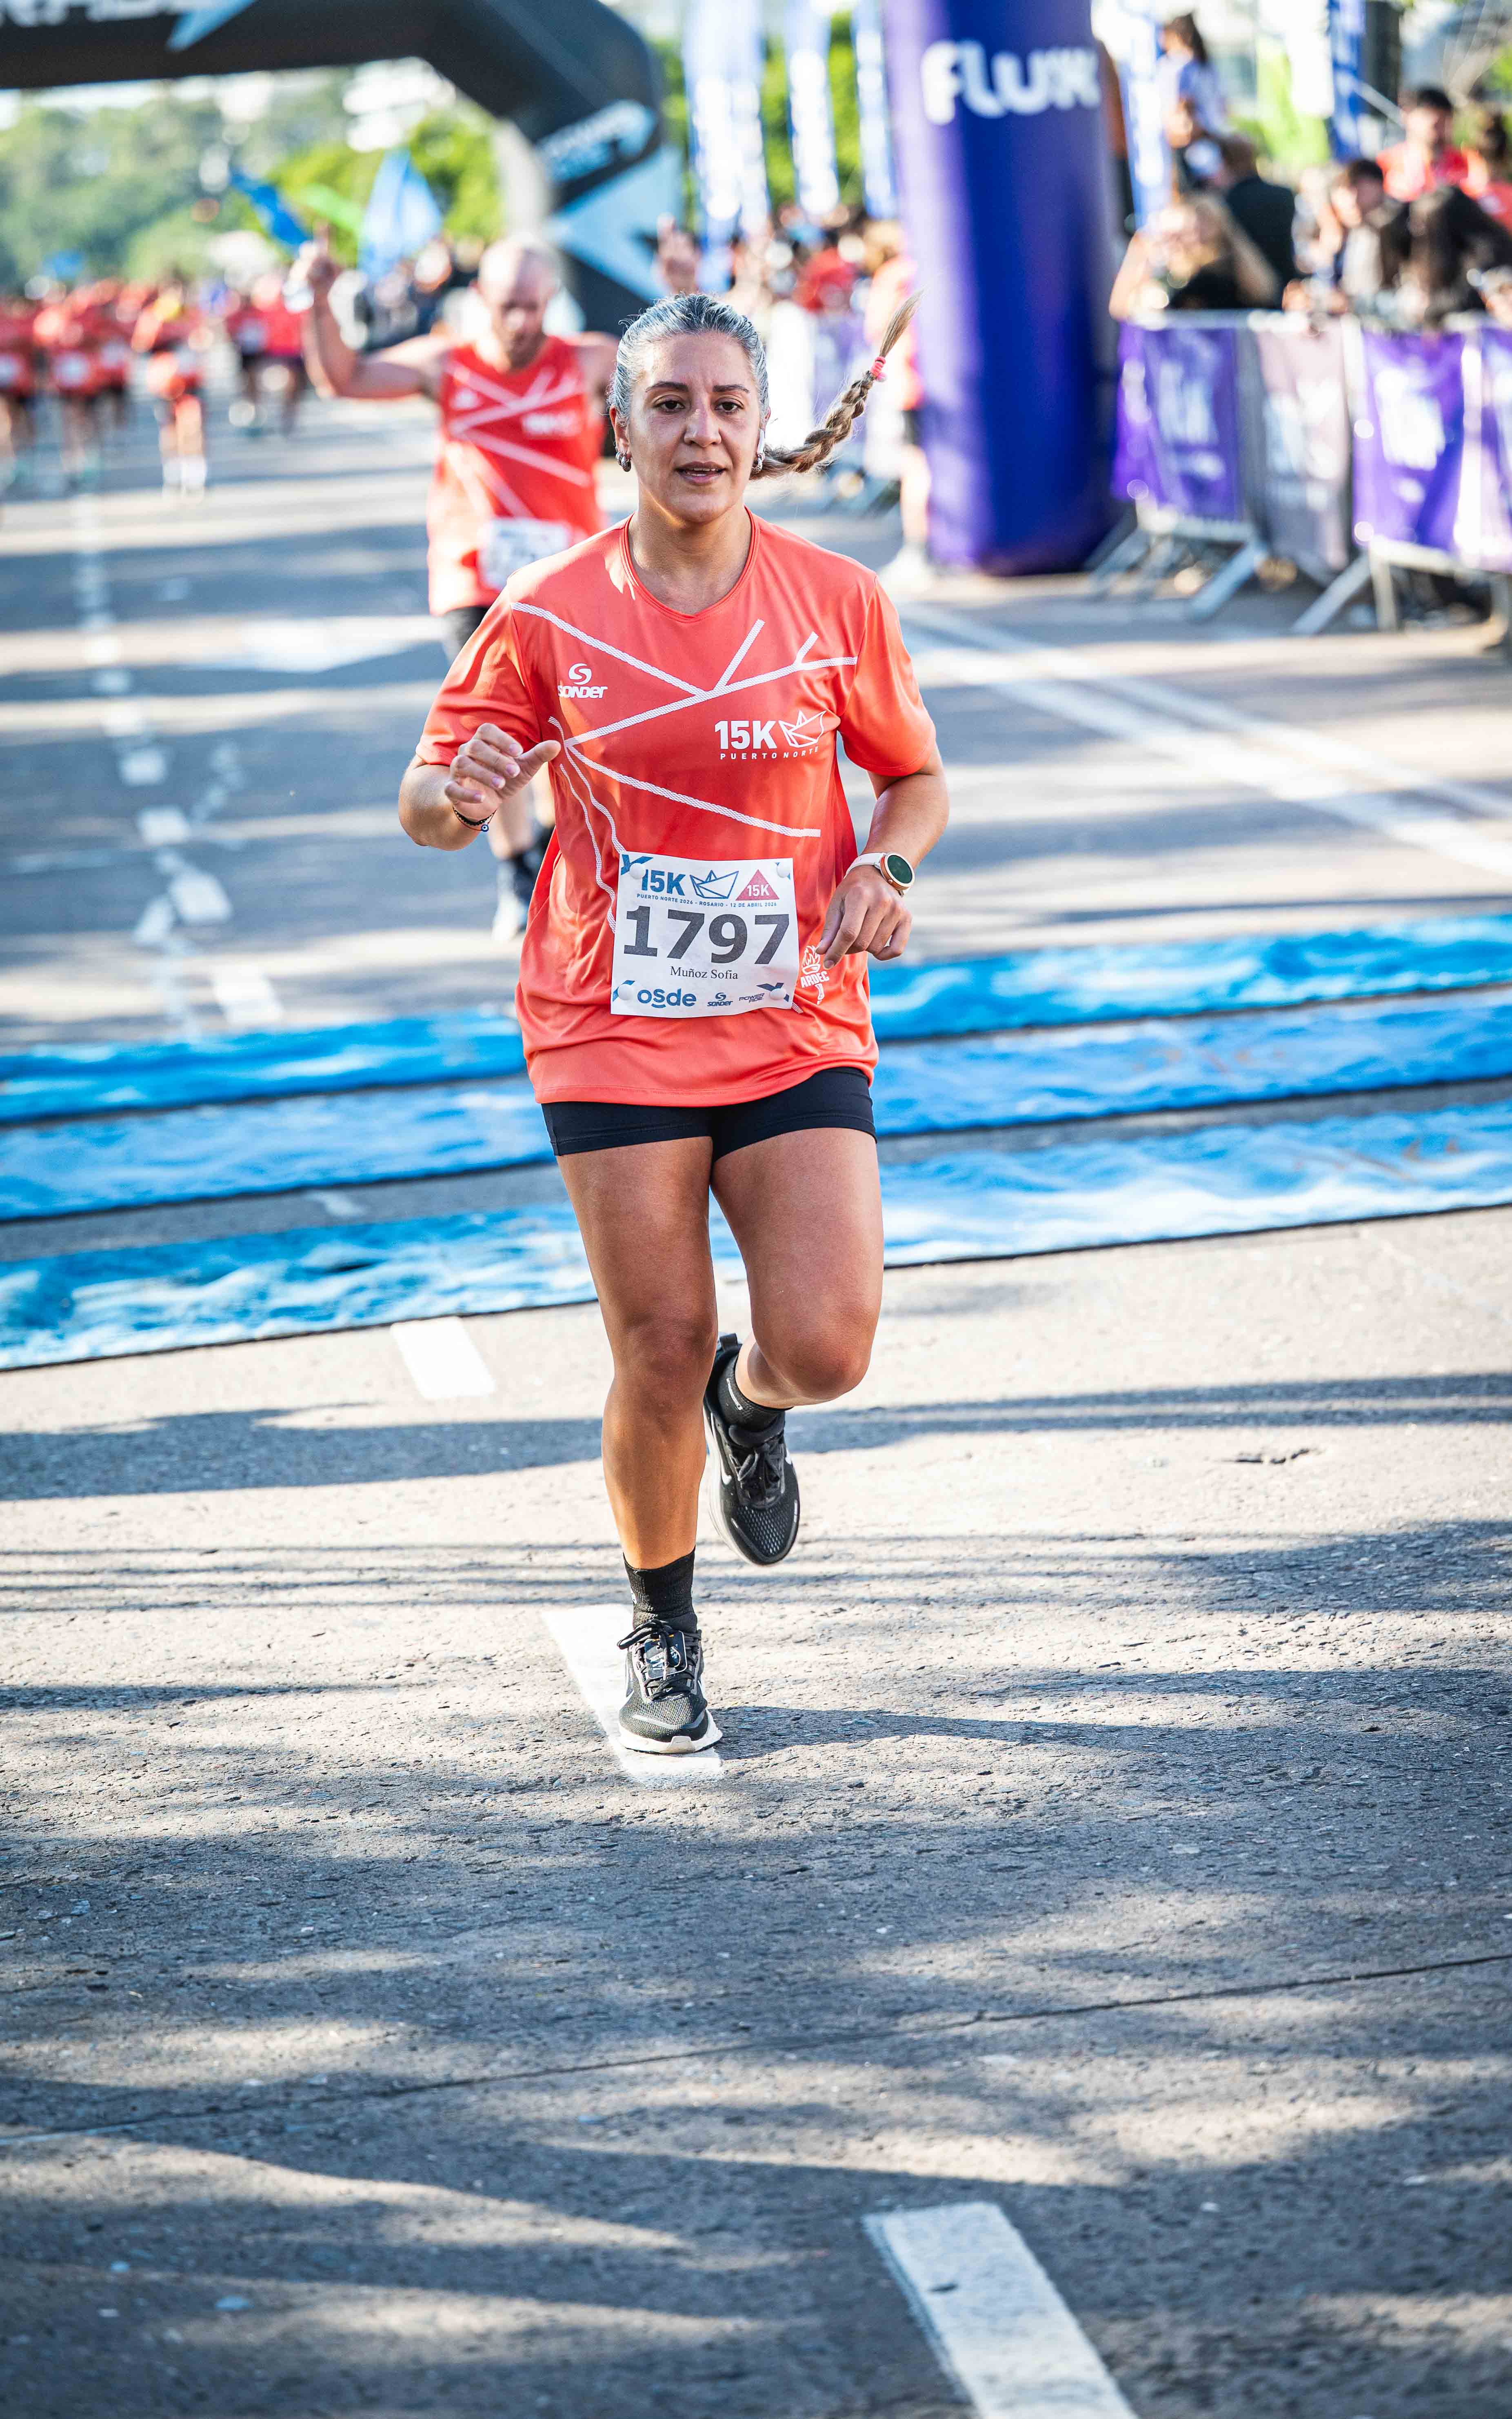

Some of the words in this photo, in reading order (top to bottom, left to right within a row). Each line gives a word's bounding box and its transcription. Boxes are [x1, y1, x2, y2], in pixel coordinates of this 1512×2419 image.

[715, 721, 777, 749] 15K
[783, 746, 819, 758] NORTE
[642, 869, 686, 895] 15K
[747, 884, 770, 897] 15K
[624, 906, 789, 964] 1797
[670, 966, 708, 978] Muñoz
[800, 971, 830, 988] ARDEC
[637, 988, 697, 1008] osde
[739, 993, 765, 1001] POWER
